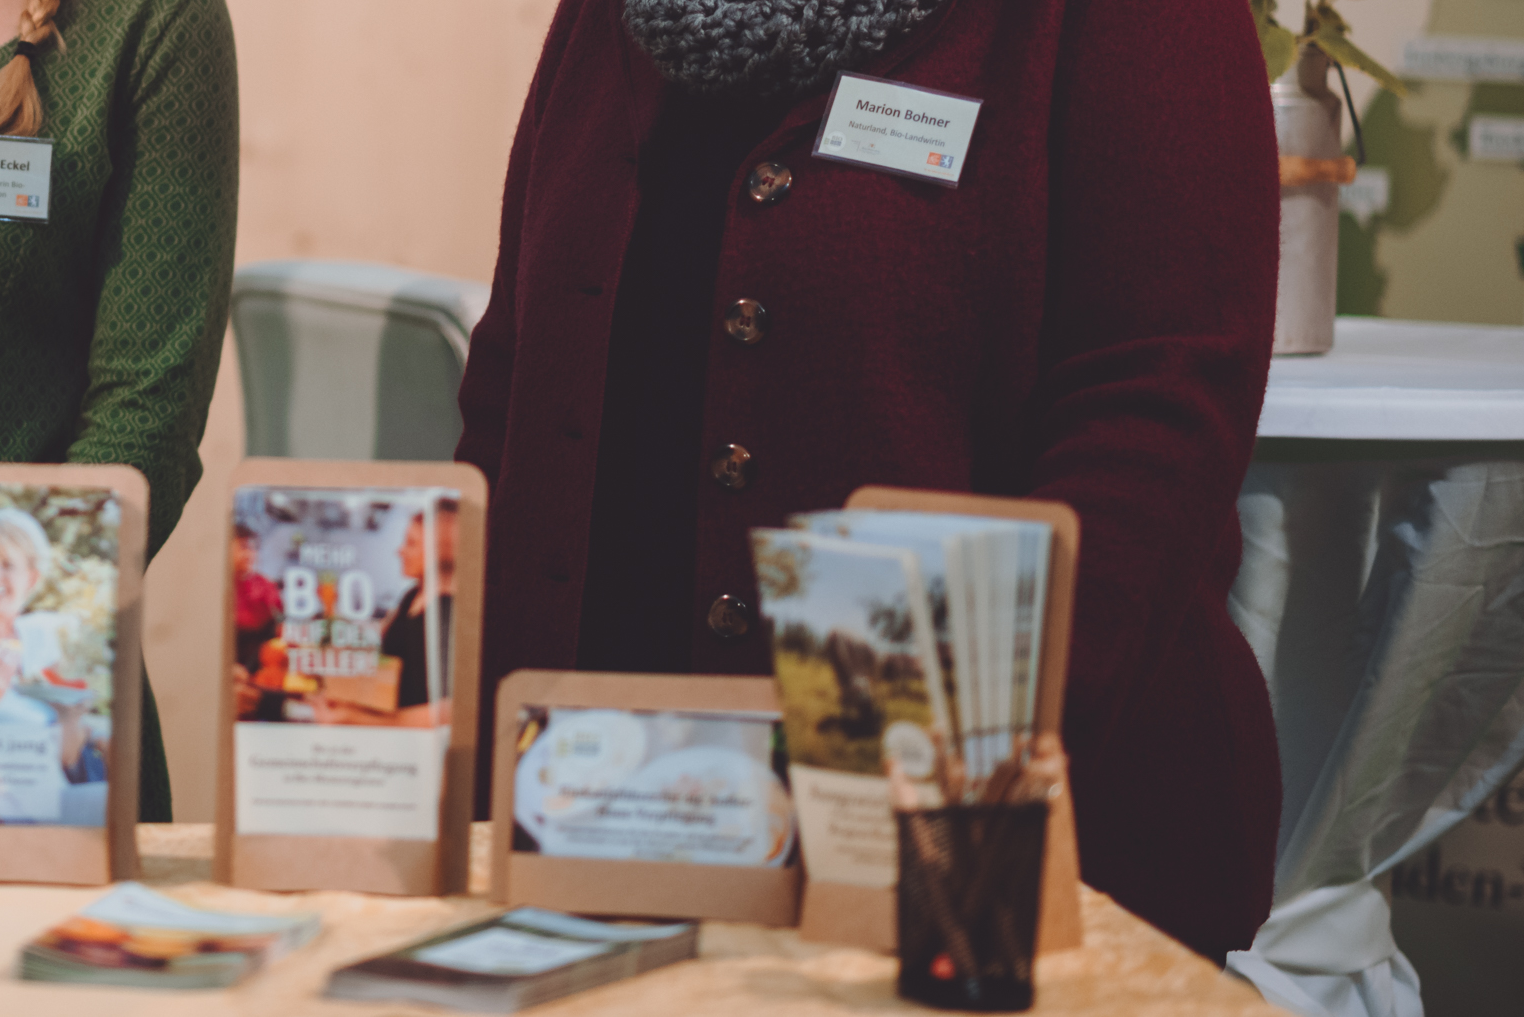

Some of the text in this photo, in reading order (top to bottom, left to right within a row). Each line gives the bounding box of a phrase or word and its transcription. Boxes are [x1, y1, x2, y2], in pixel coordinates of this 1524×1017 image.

[855, 99, 951, 128] Marion Bohner
[848, 120, 946, 148] Naturland, Bio-Landwirtin
[0, 159, 30, 172] Eckel
[11, 181, 26, 190] Bio-
